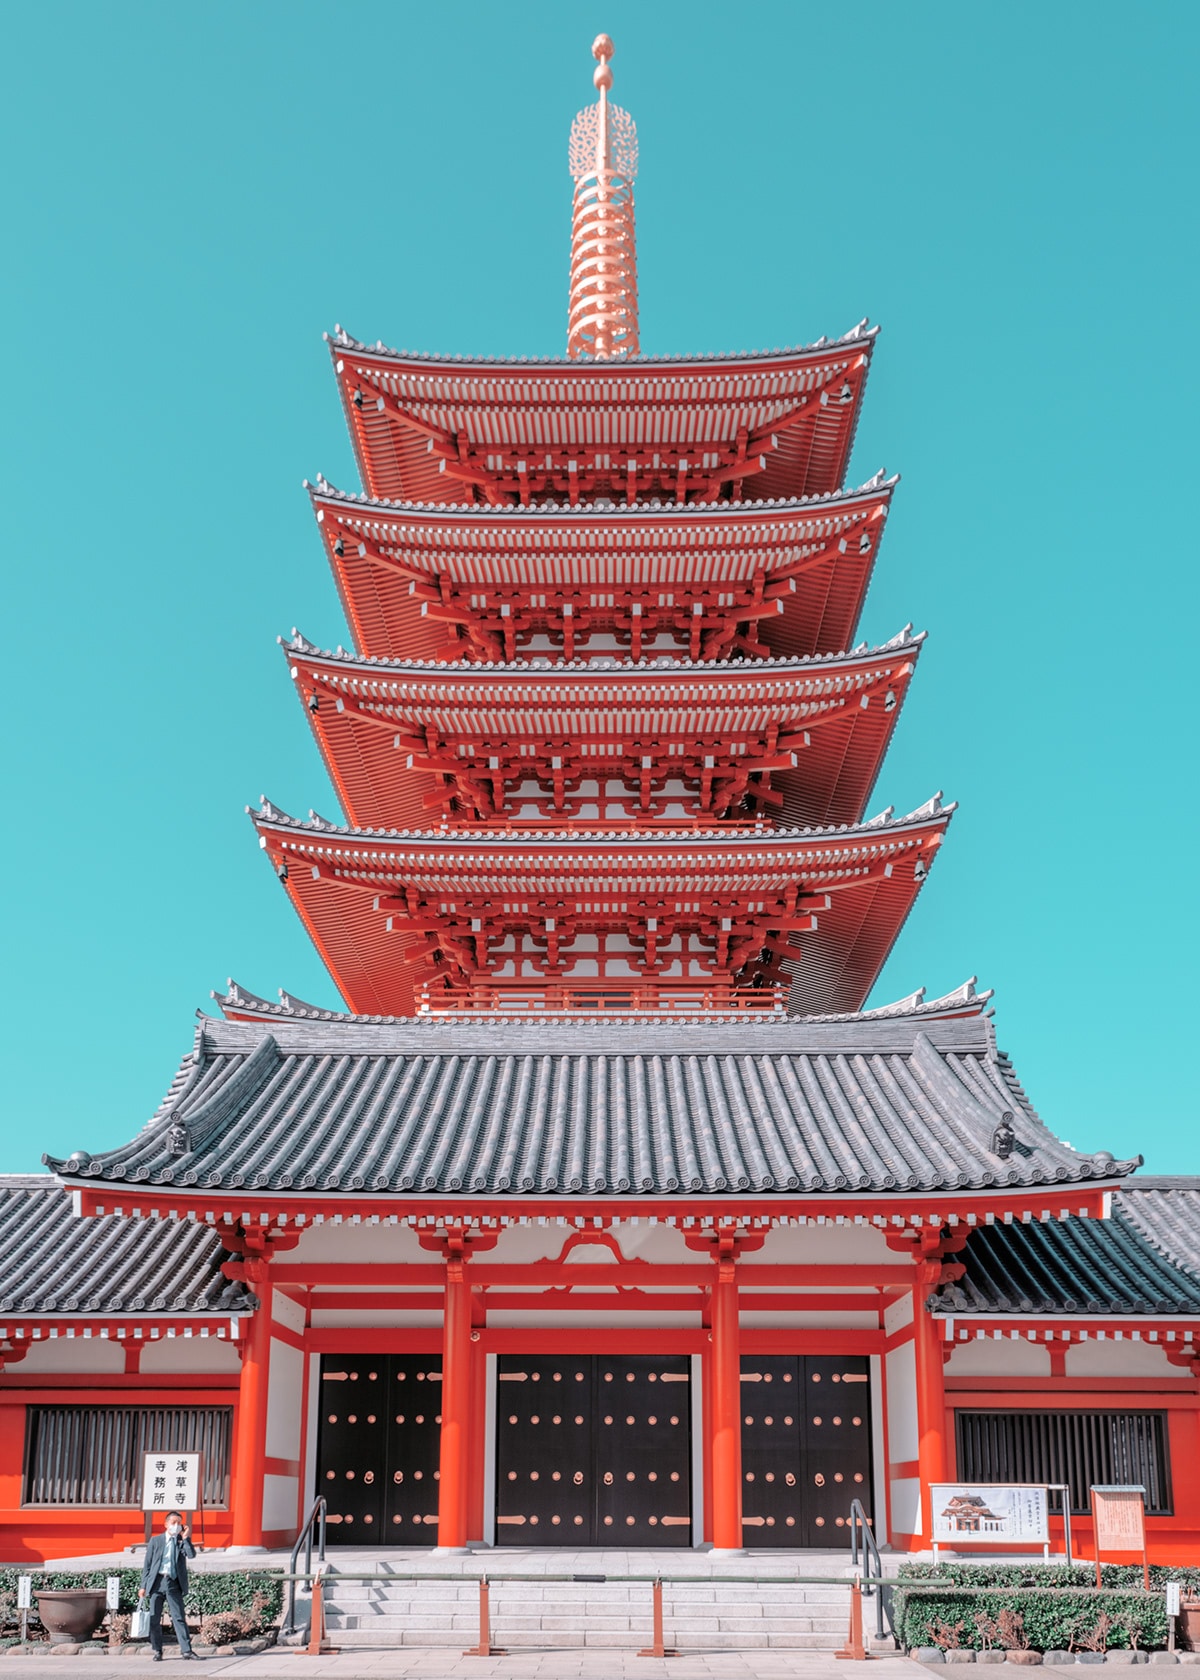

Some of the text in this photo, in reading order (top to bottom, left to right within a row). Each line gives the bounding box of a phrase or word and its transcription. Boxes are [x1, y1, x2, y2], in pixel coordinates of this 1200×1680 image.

[153, 1460, 166, 1504] 寺務所
[175, 1460, 188, 1504] 浅草寺
